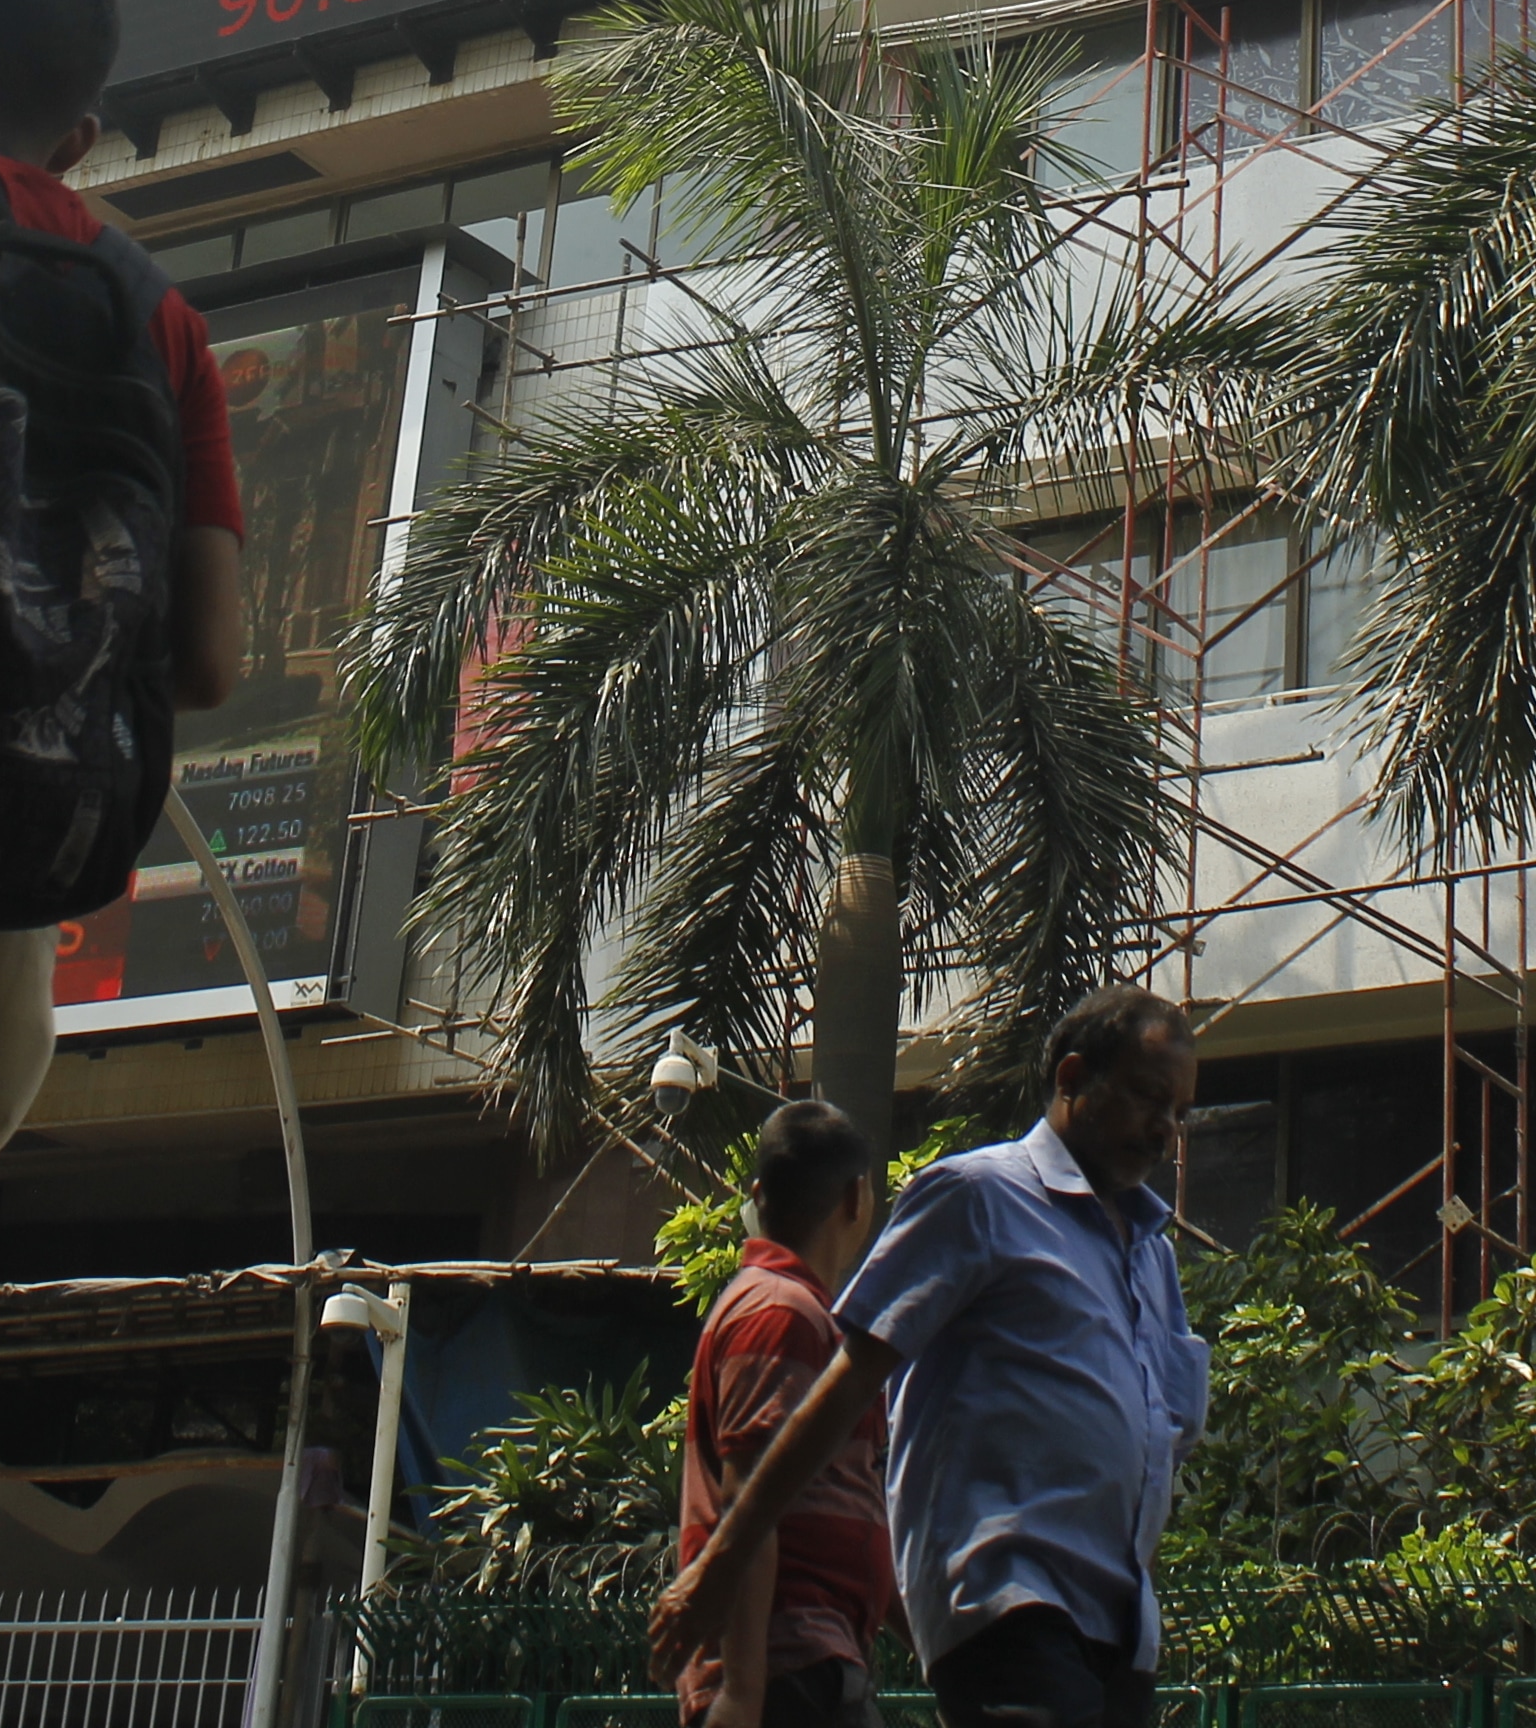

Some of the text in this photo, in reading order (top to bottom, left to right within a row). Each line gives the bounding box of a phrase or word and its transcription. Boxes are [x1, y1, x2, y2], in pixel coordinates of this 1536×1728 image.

[249, 749, 316, 774] Futures
[228, 782, 307, 812] 7098.25
[238, 819, 303, 846] 122.50
[242, 858, 298, 881] Cotton
